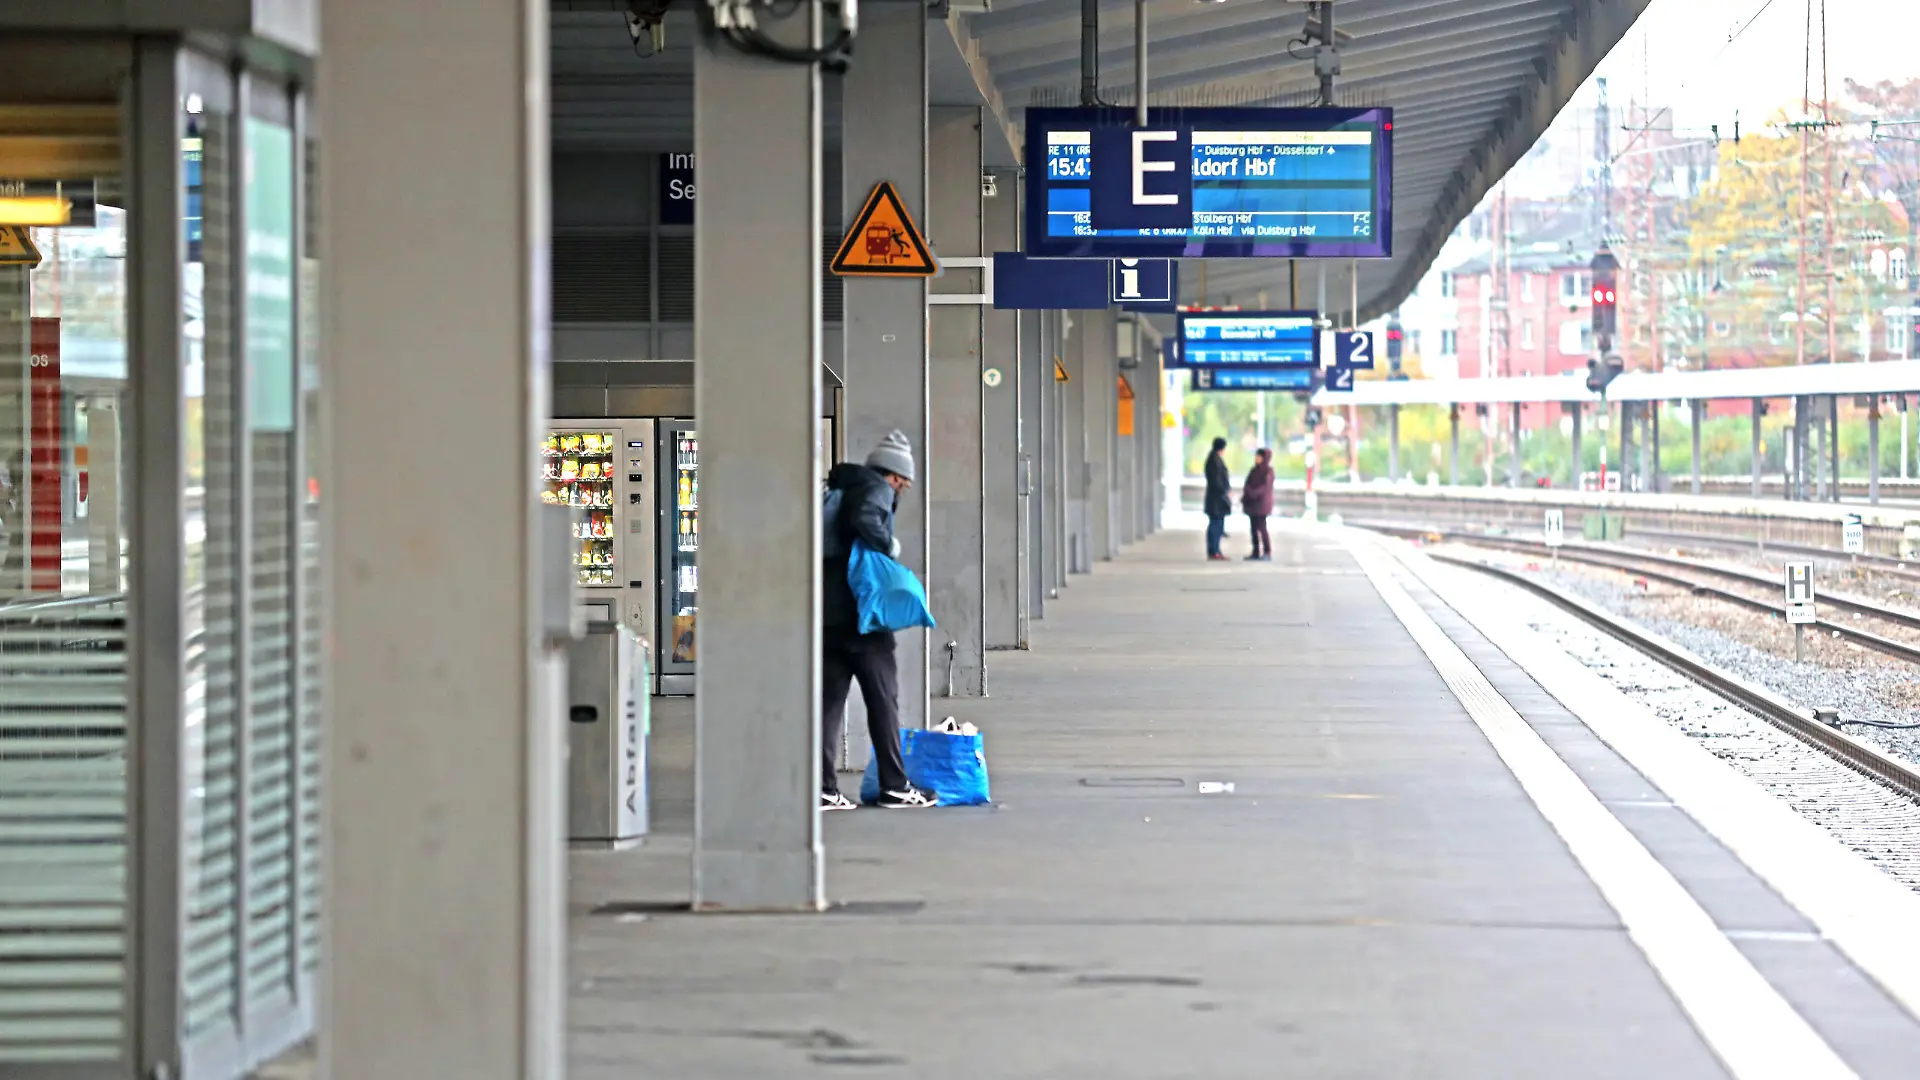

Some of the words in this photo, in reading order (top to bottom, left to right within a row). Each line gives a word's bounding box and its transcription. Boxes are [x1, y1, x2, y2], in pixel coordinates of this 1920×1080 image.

[1048, 146, 1060, 156] RE
[1063, 146, 1074, 156] 11
[1204, 146, 1245, 157] Duisburg
[1247, 146, 1264, 155] Hbf
[1273, 146, 1325, 156] Düsseldorf
[1132, 131, 1178, 205] E
[1191, 158, 1239, 176] ldorf
[1245, 157, 1276, 176] Hbf
[1193, 213, 1233, 225] Stolberg
[1236, 213, 1252, 223] Hbf
[1193, 225, 1215, 236] Köln
[1216, 225, 1233, 236] Hbf
[1241, 226, 1255, 236] via
[1257, 225, 1297, 237] Duisburg
[1299, 225, 1316, 236] Hbf
[1353, 225, 1370, 236] F-C
[1350, 332, 1369, 362] 2
[1336, 368, 1351, 388] 2
[1788, 565, 1810, 599] H
[625, 699, 637, 816] Abfall
